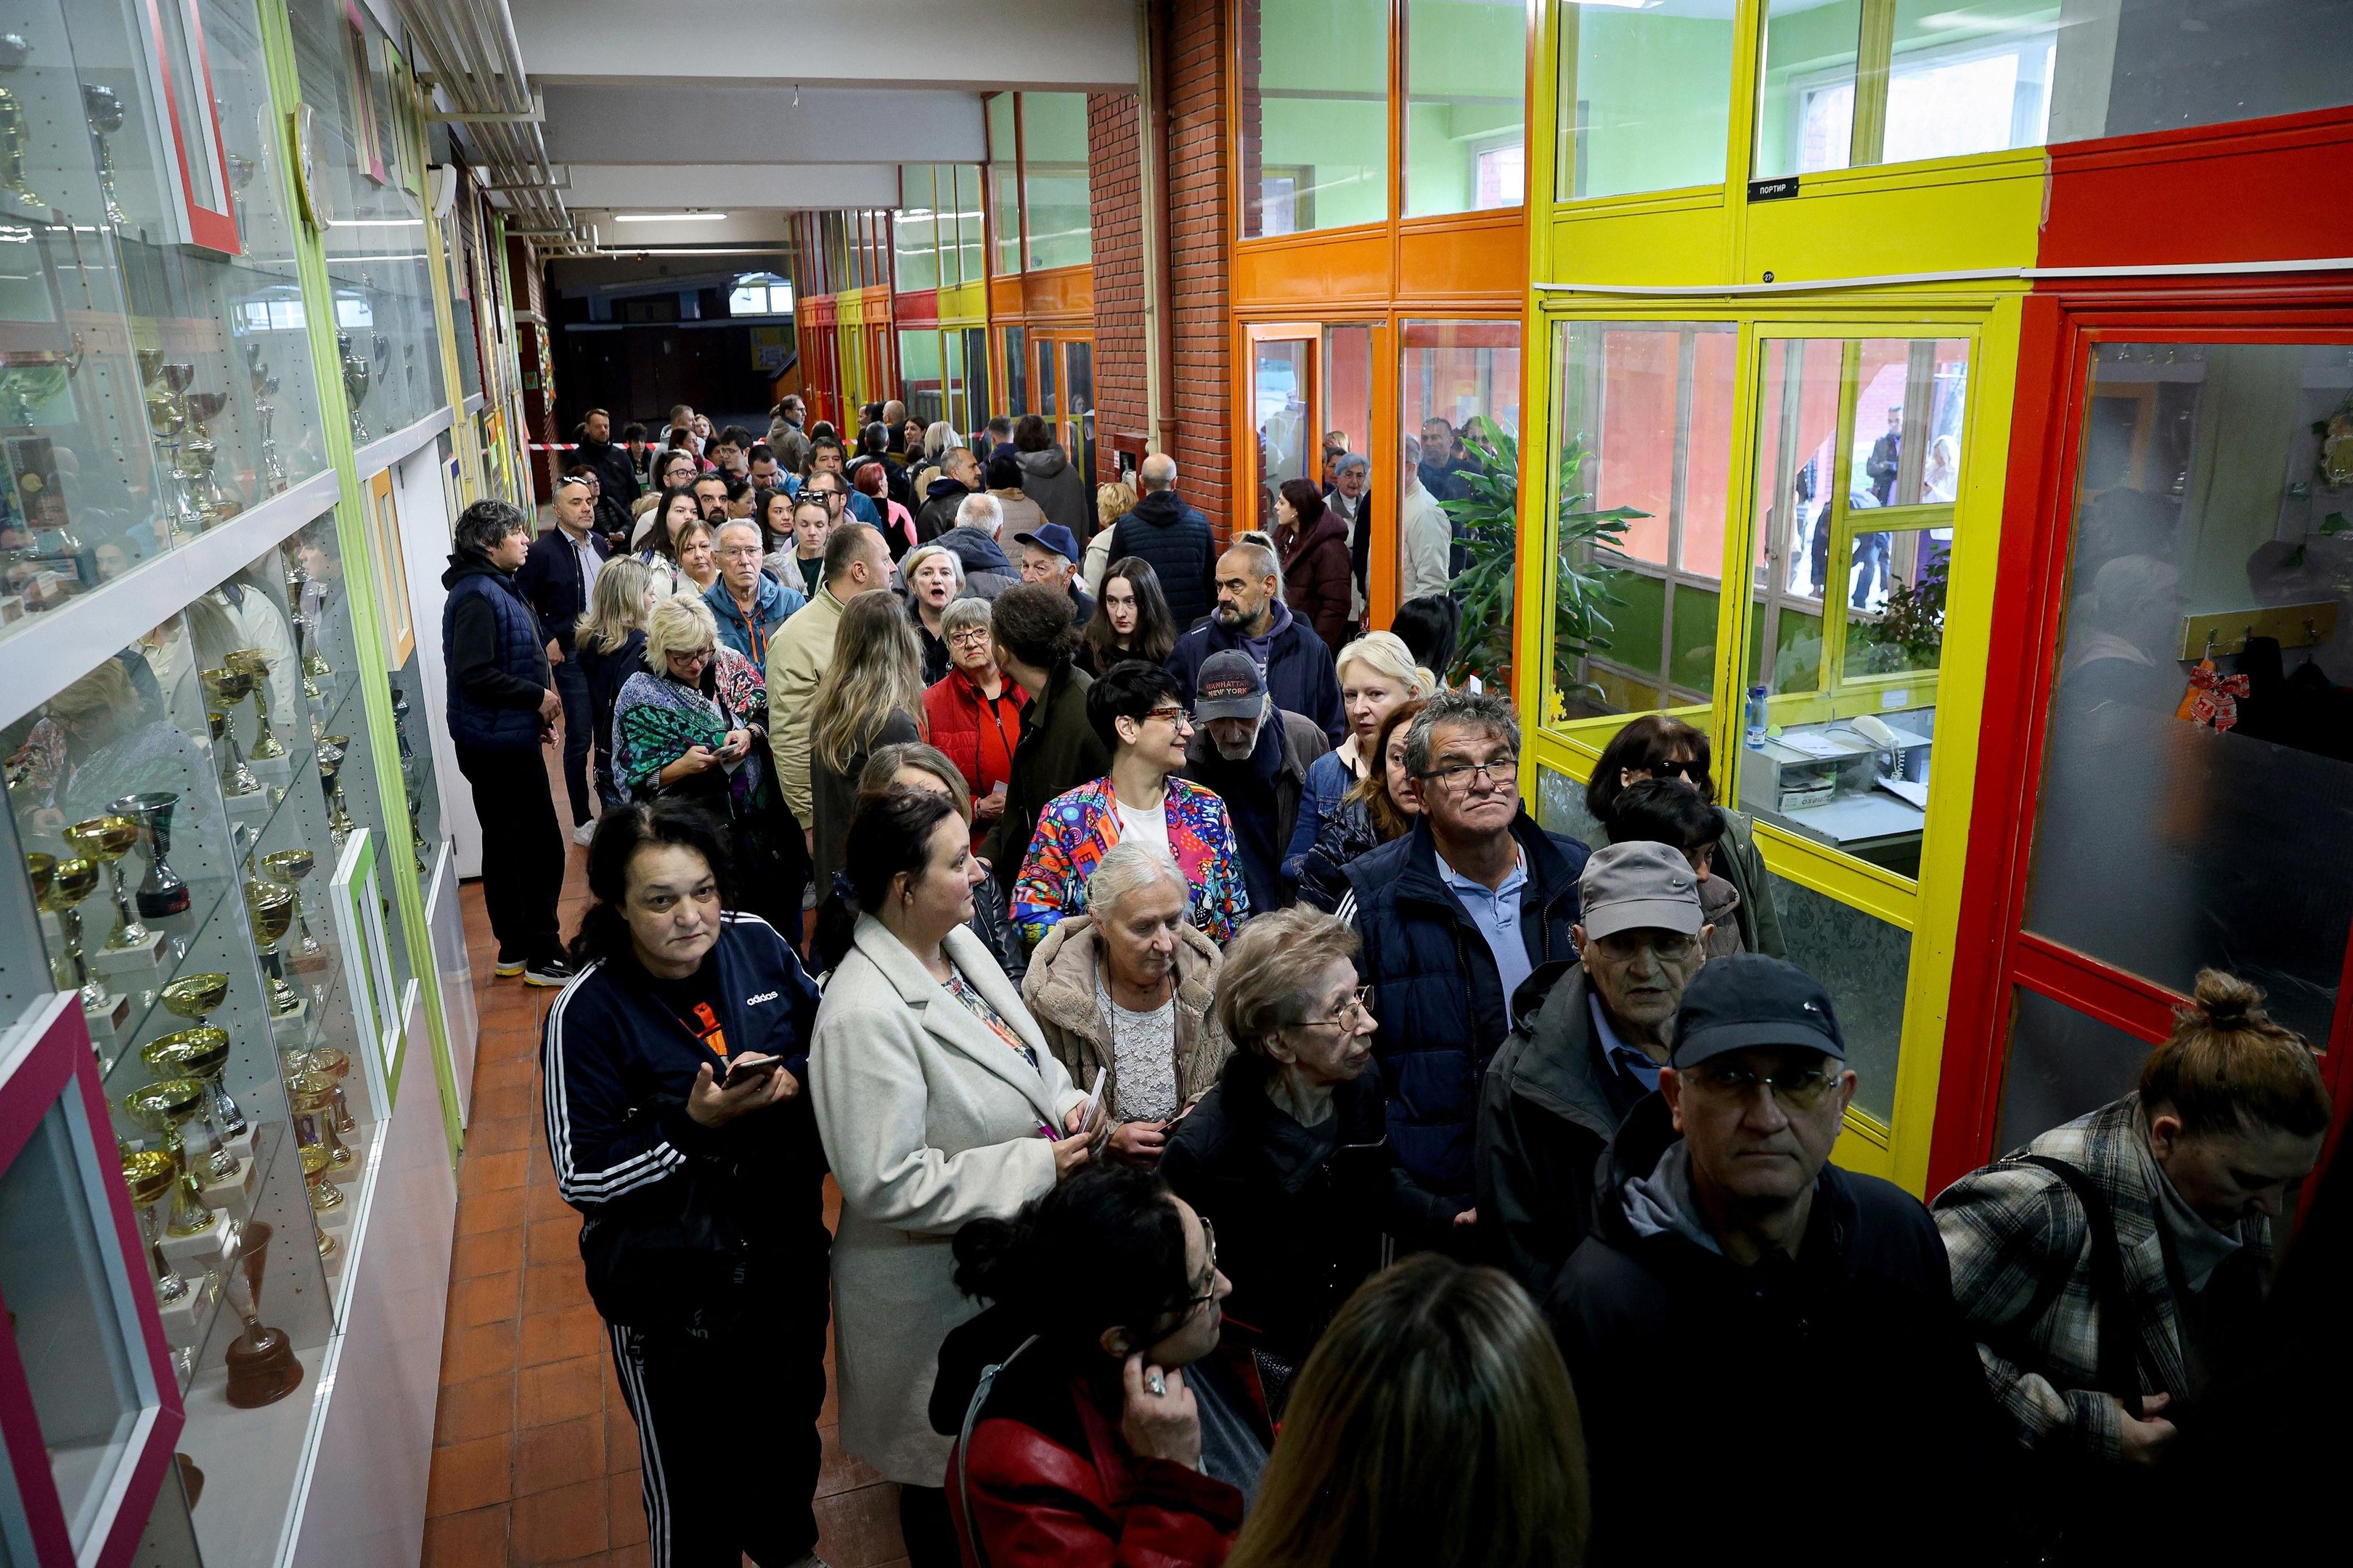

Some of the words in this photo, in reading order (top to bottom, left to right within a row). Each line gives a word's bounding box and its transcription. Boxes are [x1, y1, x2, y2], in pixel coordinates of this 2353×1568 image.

[1760, 184, 1787, 195] ПОРТИР
[1205, 681, 1249, 690] MANHATTAN
[1208, 688, 1224, 698] NEW
[746, 991, 778, 1006] adidas
